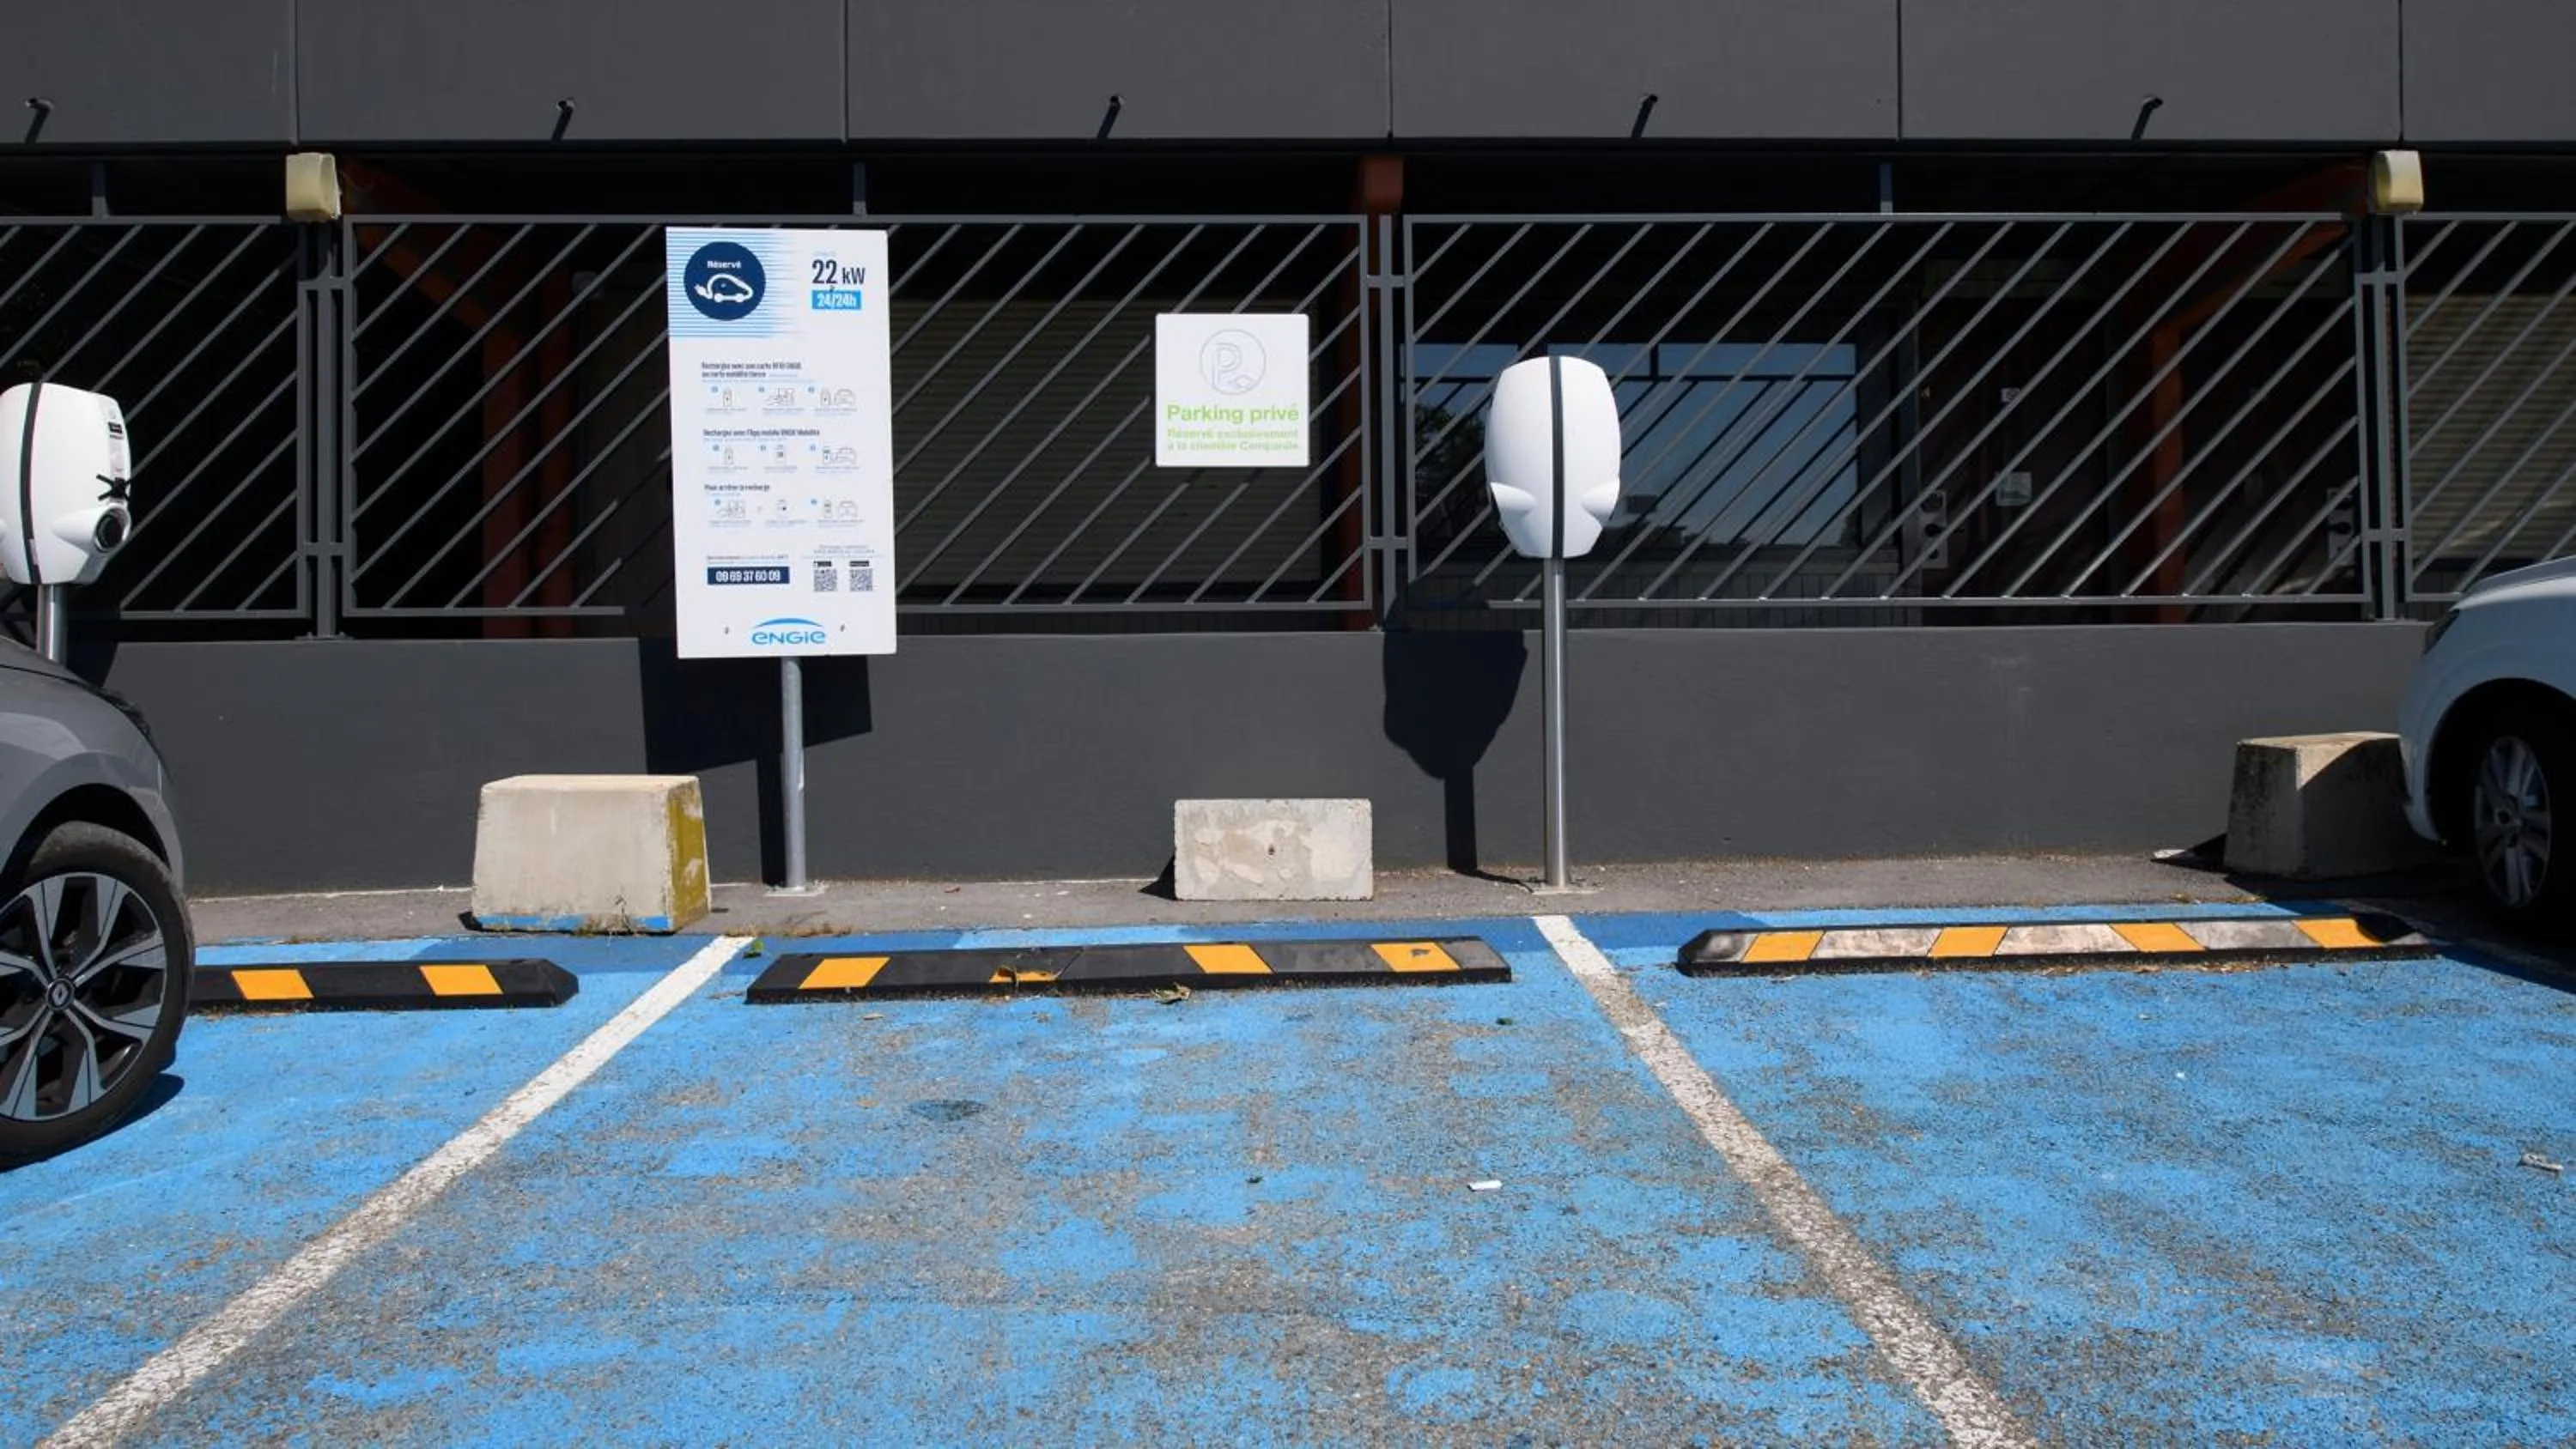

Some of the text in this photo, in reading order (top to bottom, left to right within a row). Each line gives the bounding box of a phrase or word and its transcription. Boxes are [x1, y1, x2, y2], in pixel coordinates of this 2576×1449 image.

[811, 259, 866, 285] 22 kW
[817, 294, 856, 307] 24/24h
[1167, 403, 1299, 425] Parking privé
[743, 569, 755, 582] 37
